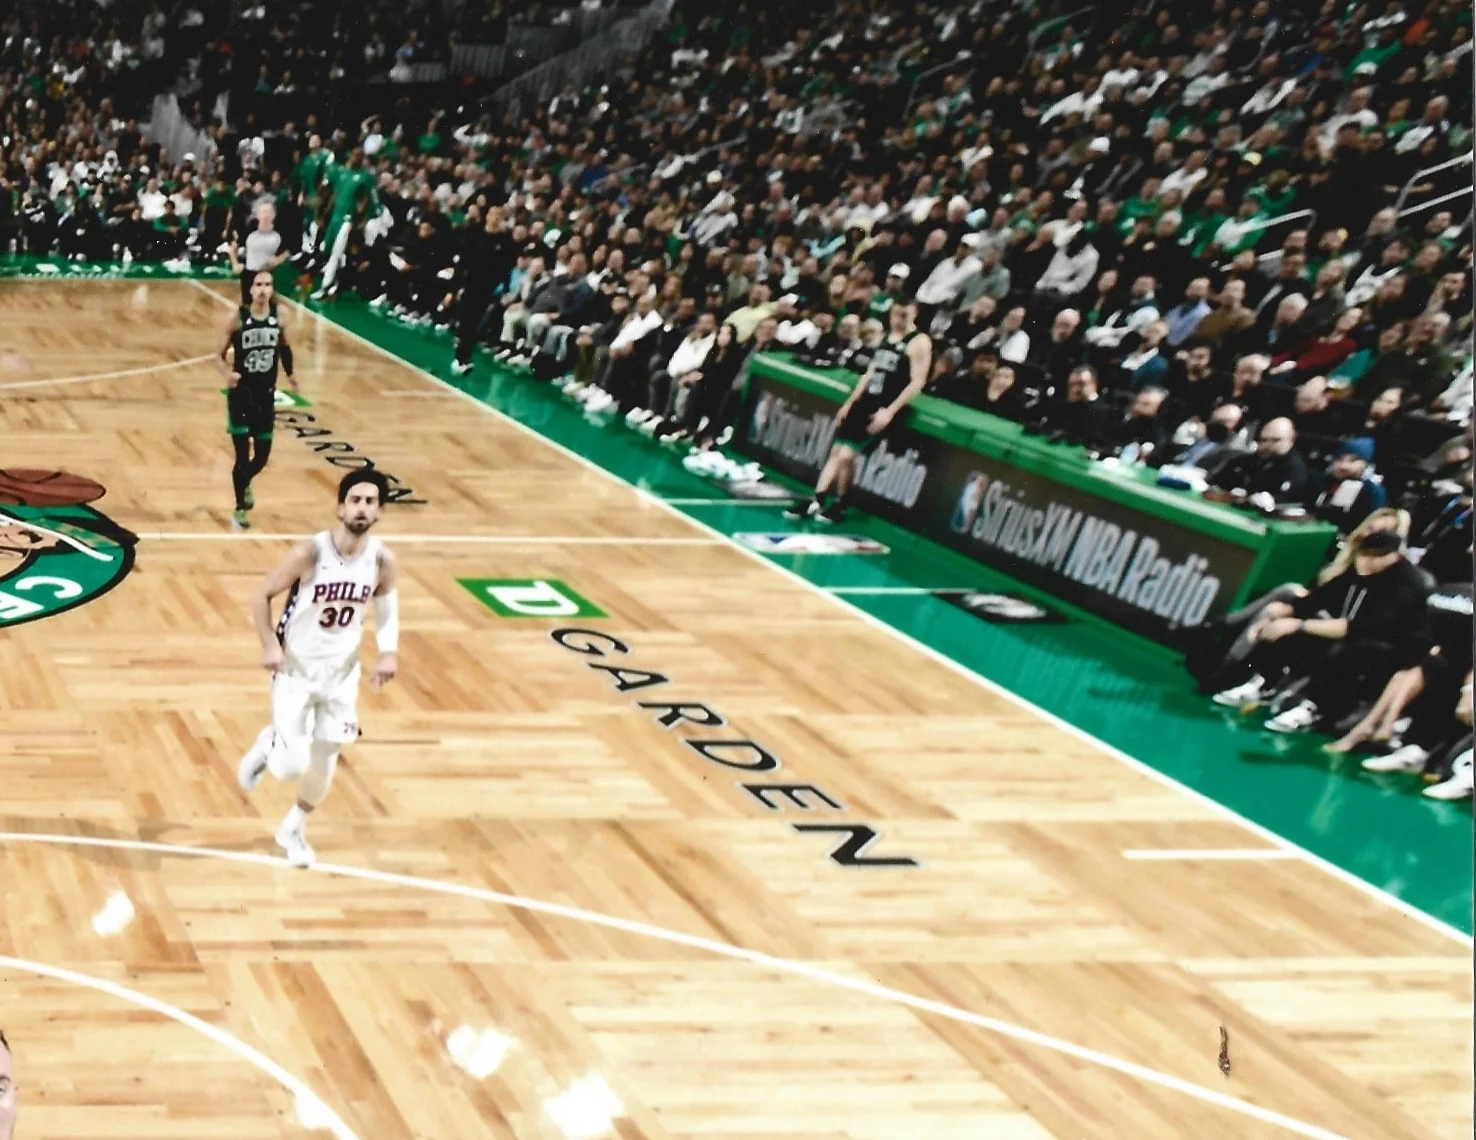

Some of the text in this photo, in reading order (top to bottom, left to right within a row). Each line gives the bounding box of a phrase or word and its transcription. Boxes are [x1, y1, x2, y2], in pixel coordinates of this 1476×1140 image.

[244, 348, 275, 372] 45
[274, 410, 428, 504] GARDN
[972, 480, 1221, 630] SiriusXM NBA Radio
[319, 606, 355, 628] 30
[550, 628, 919, 867] GARDEN
